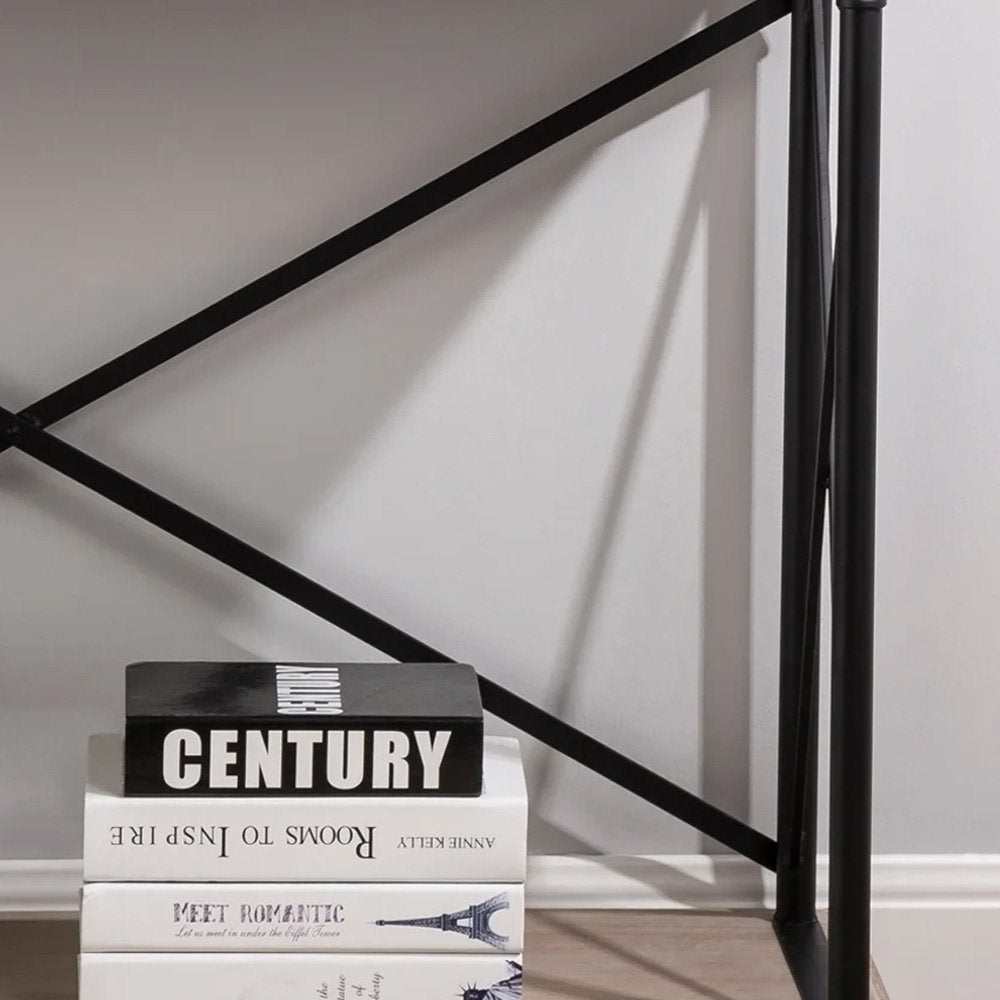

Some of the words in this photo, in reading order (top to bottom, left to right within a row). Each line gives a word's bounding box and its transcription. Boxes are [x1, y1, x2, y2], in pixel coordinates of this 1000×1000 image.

[276, 665, 343, 715] CENTURY
[163, 729, 451, 789] CENTURY
[242, 825, 274, 846] TO
[398, 836, 445, 849] KELLY
[449, 836, 495, 849] ANNIE
[173, 902, 229, 923] MEET
[240, 904, 345, 924] ROMANTIC
[175, 925, 193, 937] Let
[206, 928, 227, 937] meet
[240, 926, 267, 938] under
[269, 927, 282, 937] the
[284, 925, 310, 942] Eiffel
[311, 925, 341, 937] Tower
[316, 982, 328, 999] the
[351, 984, 366, 997] of
